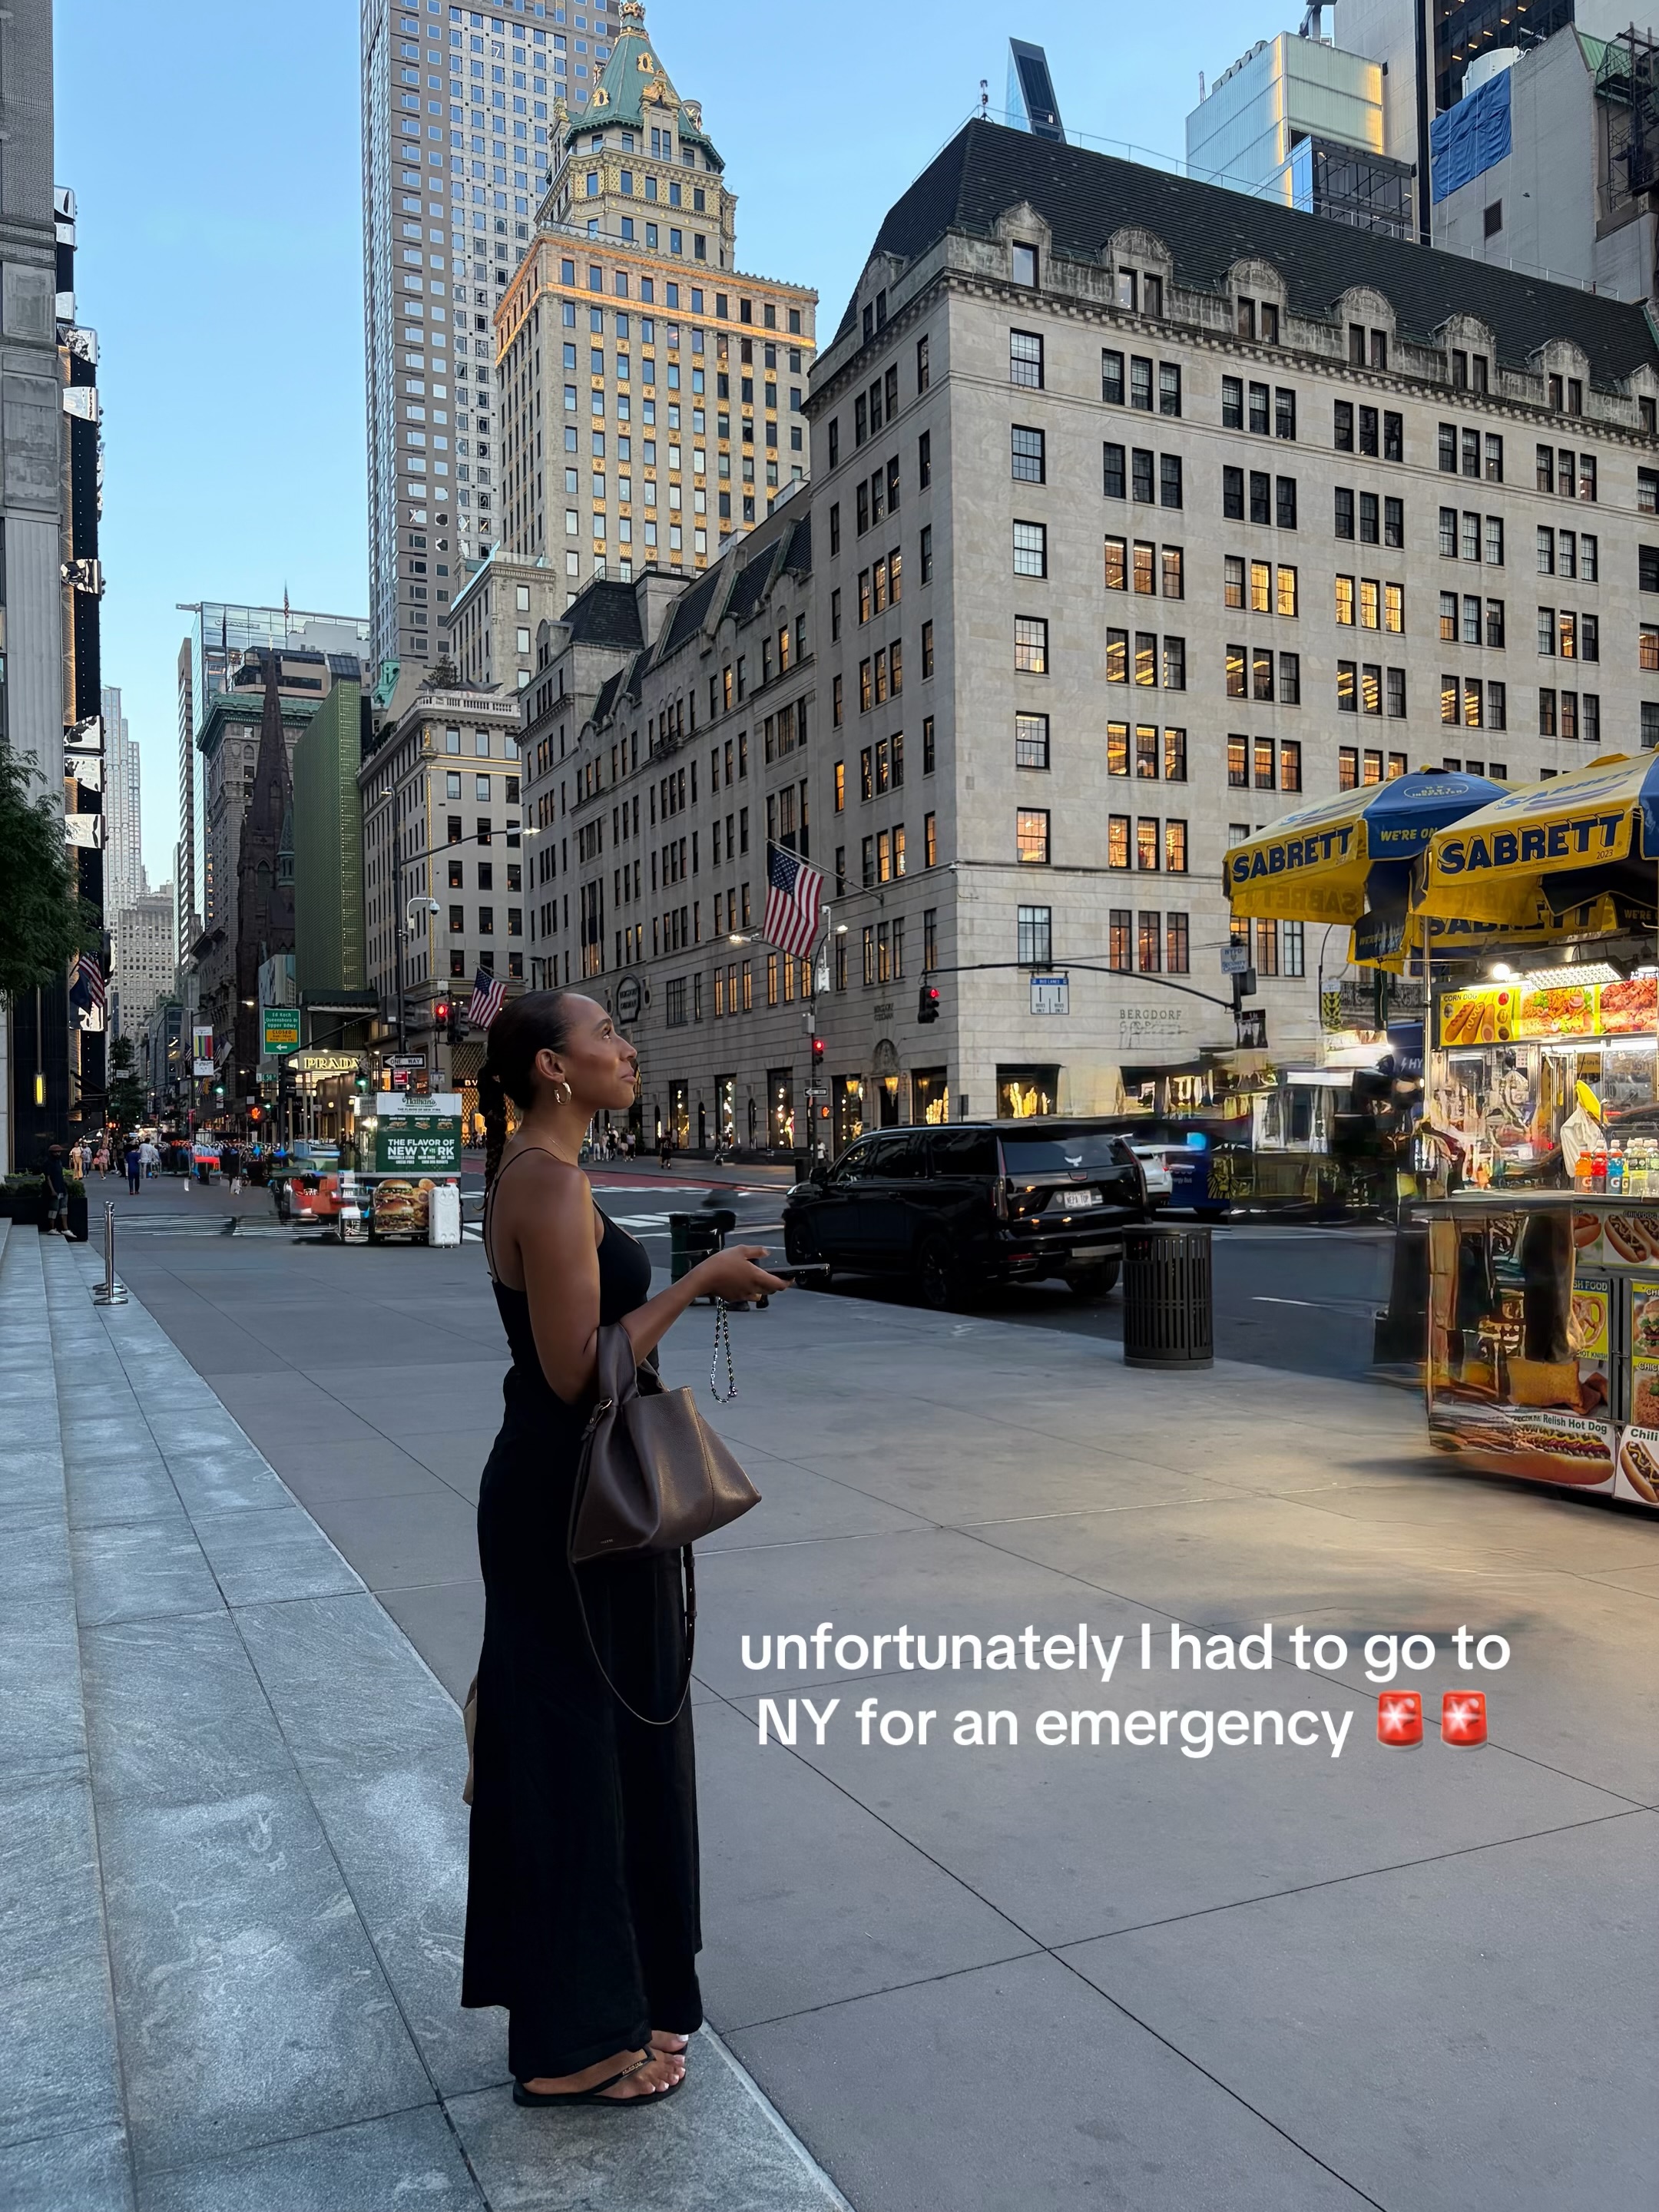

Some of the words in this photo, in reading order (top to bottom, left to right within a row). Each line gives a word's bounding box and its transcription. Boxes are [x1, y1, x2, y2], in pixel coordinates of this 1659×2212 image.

[1380, 830, 1416, 842] WE'RE
[1437, 809, 1624, 874] SABRETT
[1232, 823, 1353, 882] SABRETT
[1596, 849, 1614, 860] 2023
[1444, 994, 1461, 1002] CORN
[1463, 992, 1478, 1001] DOG
[1120, 1009, 1182, 1020] BERGDORF
[303, 1057, 359, 1069] PRADA
[402, 1097, 436, 1107] Nathan's
[388, 1147, 417, 1155] NEW
[1585, 1282, 1608, 1290] FOOD
[1543, 1414, 1566, 1426] Relish
[1568, 1419, 1585, 1430] Hot
[1588, 1421, 1607, 1435] Dog
[1631, 1429, 1658, 1442] Chili
